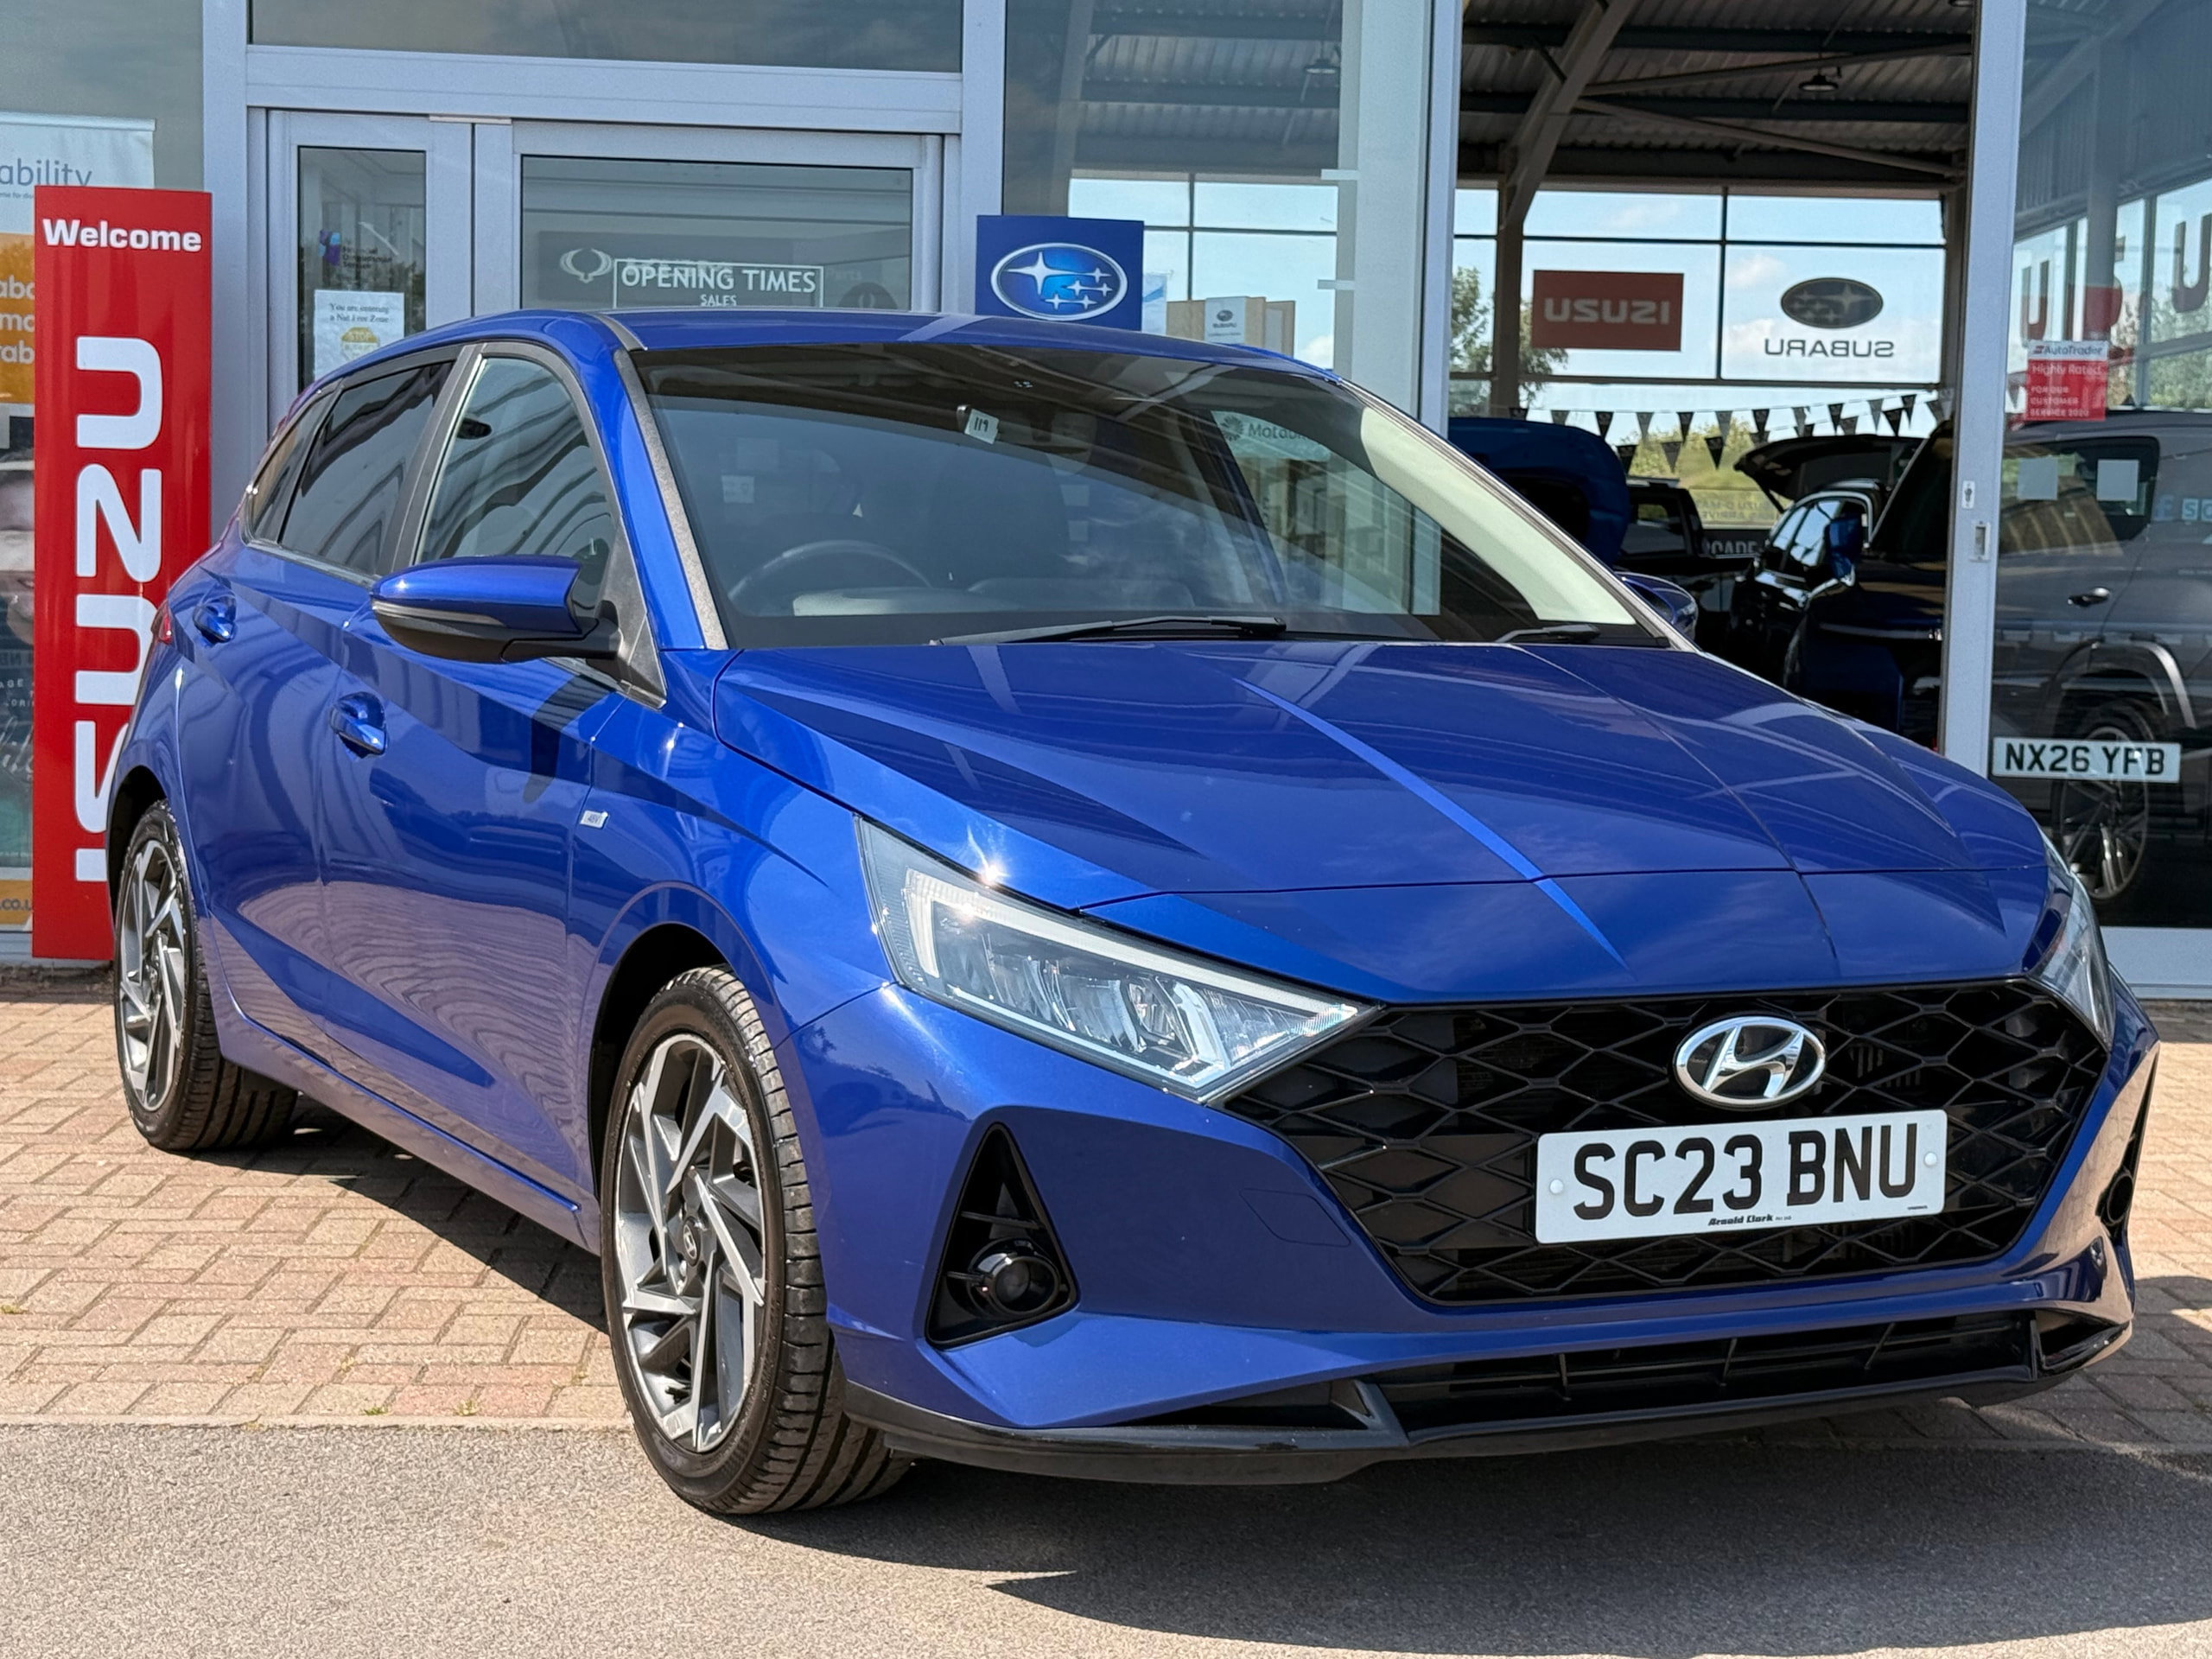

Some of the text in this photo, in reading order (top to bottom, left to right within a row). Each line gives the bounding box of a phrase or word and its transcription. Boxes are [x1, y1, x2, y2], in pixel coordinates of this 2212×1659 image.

[42, 218, 202, 252] Welcome
[621, 264, 734, 290] OPENING
[742, 269, 817, 293] TIMES
[329, 302, 346, 311] You
[700, 293, 737, 307] SALES
[2044, 346, 2103, 355] AutoTrader
[2005, 743, 2164, 775] NX26 YFB
[1573, 1123, 1917, 1220] SC23 BNU
[1707, 1216, 1744, 1226] Arnold
[1746, 1213, 1773, 1224] Clark
